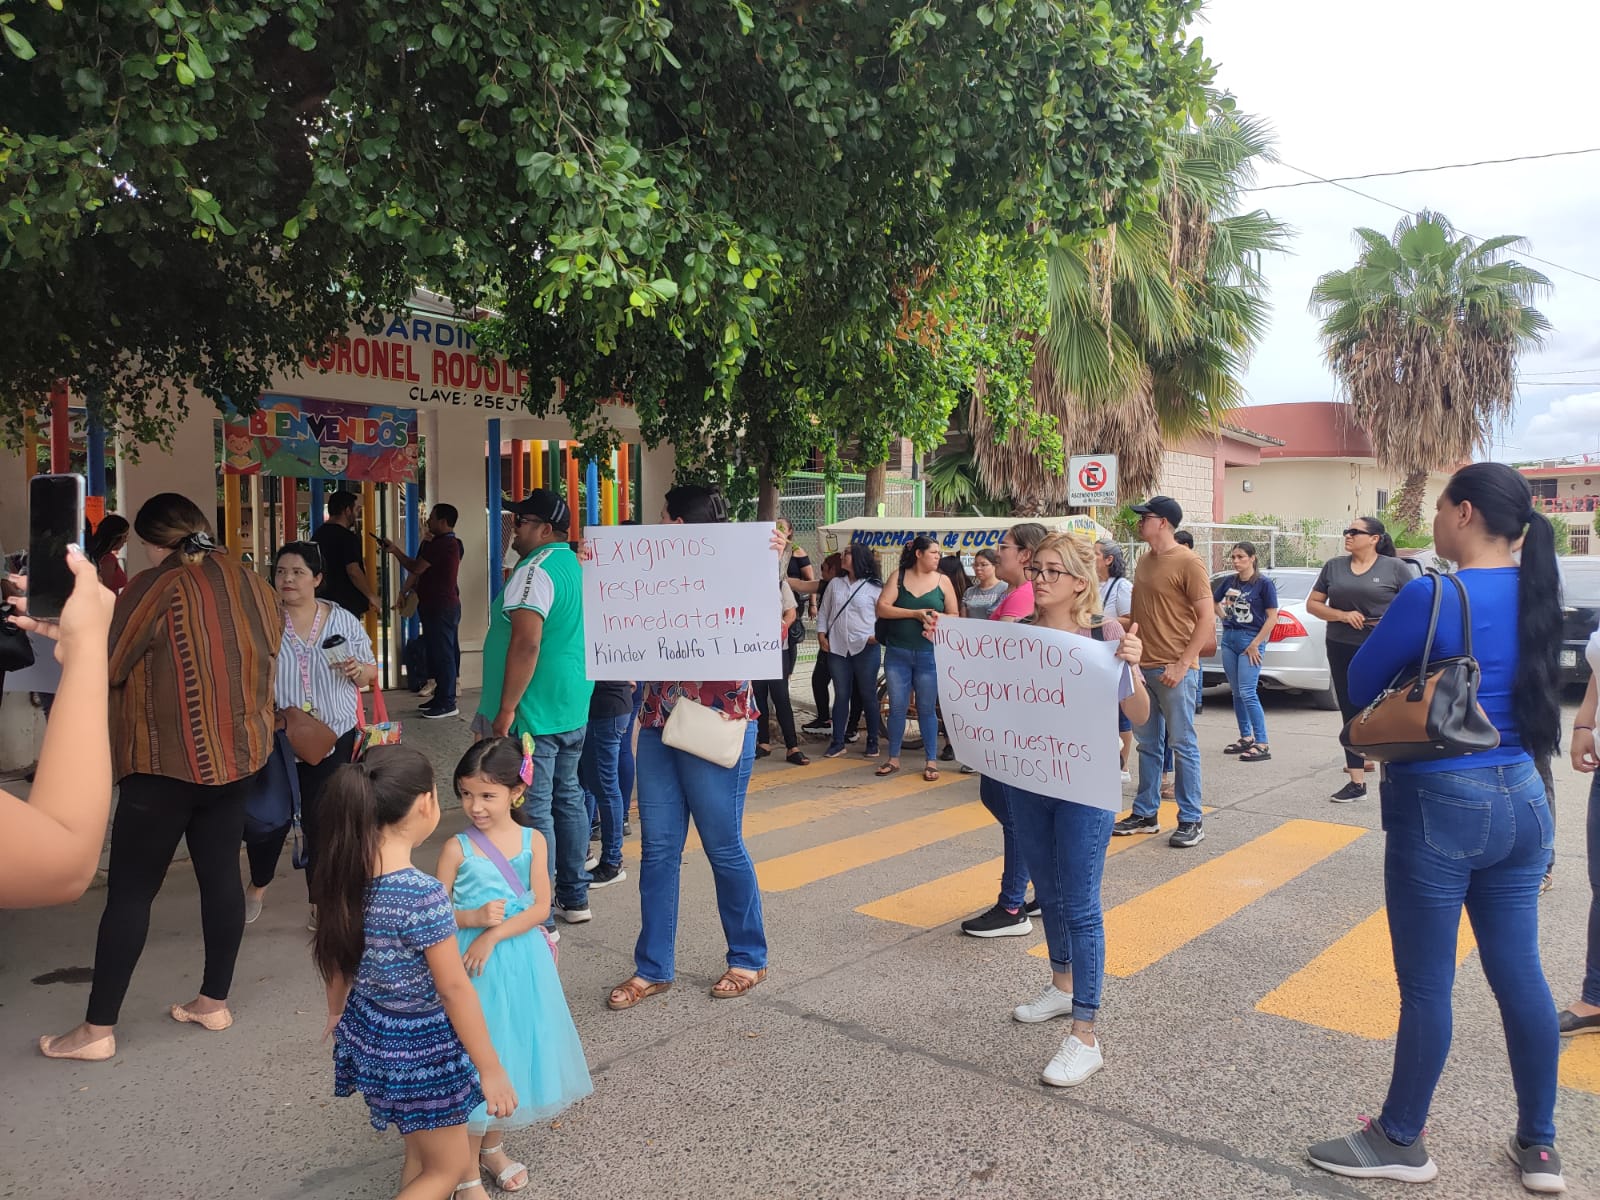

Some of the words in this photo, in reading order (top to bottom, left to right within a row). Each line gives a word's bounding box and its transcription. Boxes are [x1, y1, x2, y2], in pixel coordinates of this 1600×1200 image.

[366, 315, 477, 349] ARDIN
[432, 349, 529, 397] RODOLF
[249, 409, 408, 447] BIENVENIDOS
[943, 530, 959, 548] de
[598, 575, 706, 601] respuesta
[594, 639, 647, 666] Kinder
[708, 636, 724, 655] T
[948, 665, 1066, 712] Seguridad
[951, 713, 994, 743] Para
[1004, 729, 1092, 762] nuestros
